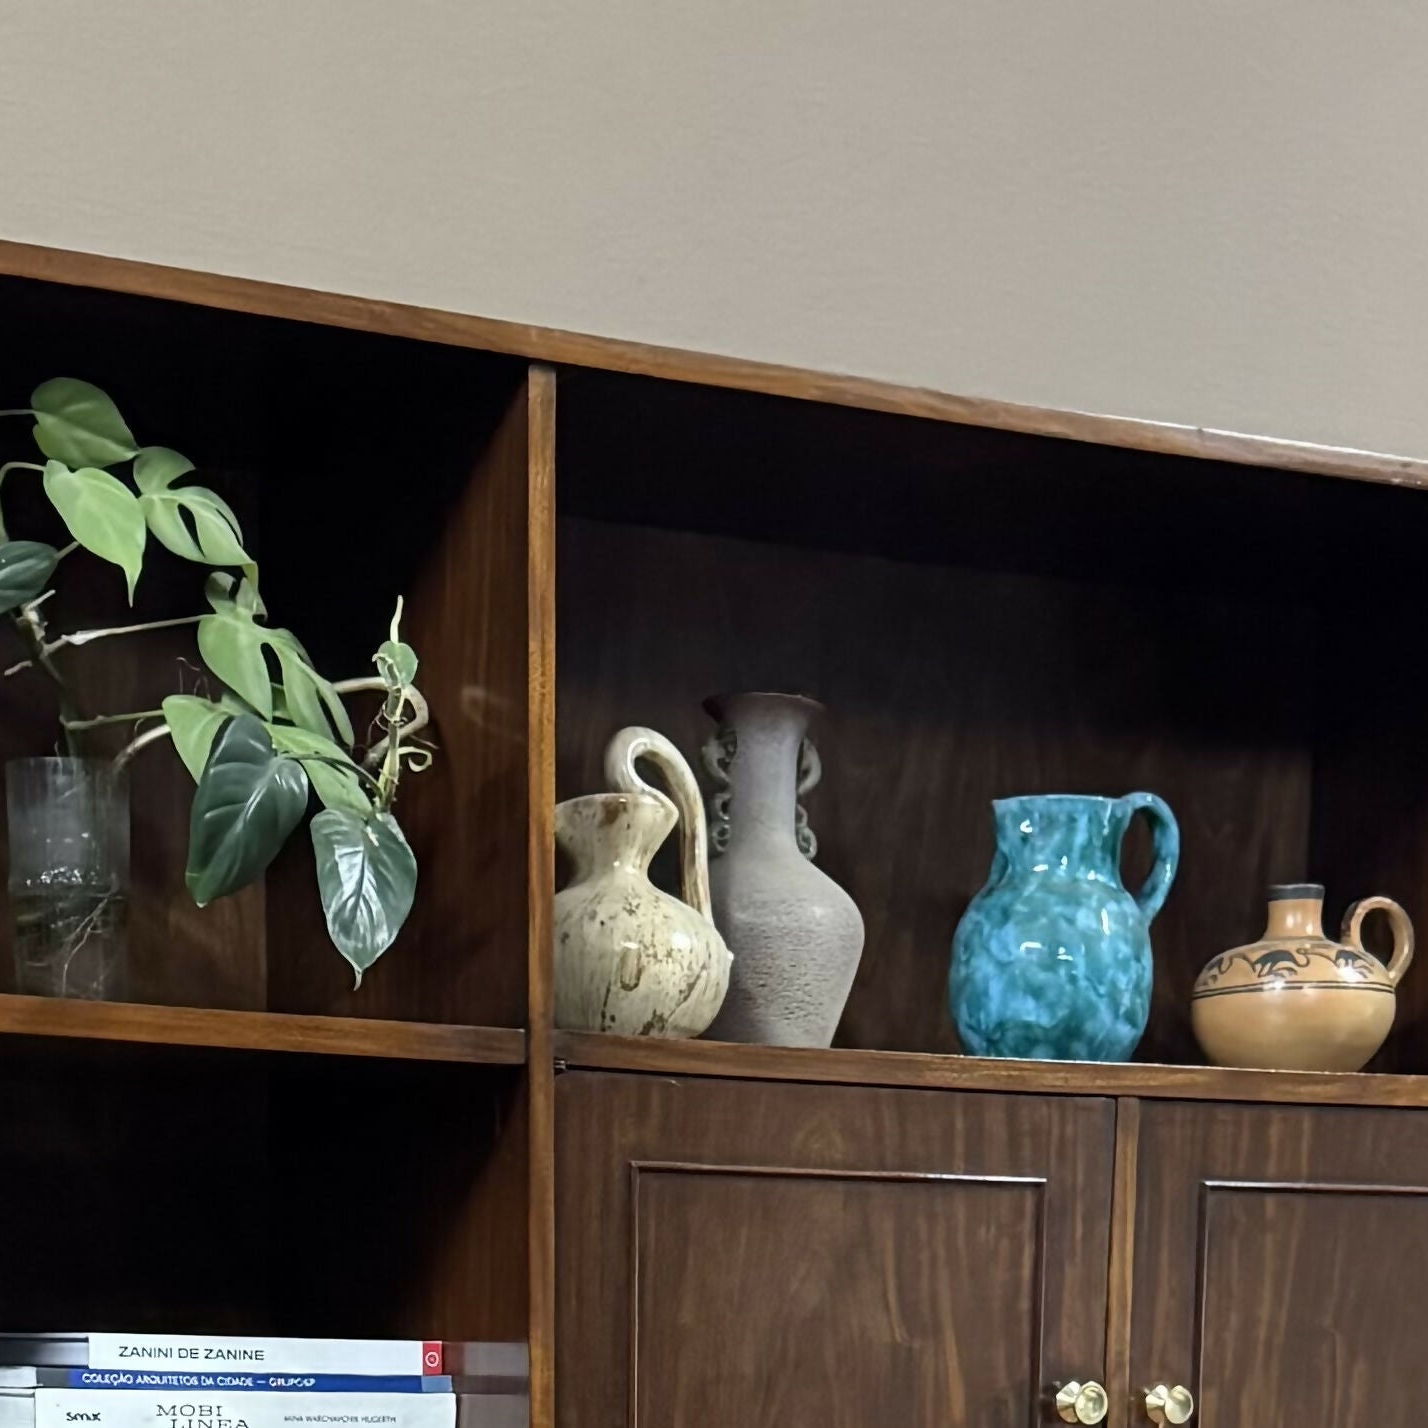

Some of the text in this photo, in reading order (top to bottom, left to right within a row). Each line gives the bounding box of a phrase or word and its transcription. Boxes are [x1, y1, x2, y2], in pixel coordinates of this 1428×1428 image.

[118, 1346, 265, 1361] ZANINI DE ZANINE
[81, 1371, 134, 1387] COLEÇÃO
[201, 1375, 215, 1386] DA
[216, 1376, 254, 1387] CIDADE
[155, 1404, 224, 1417] MOBI
